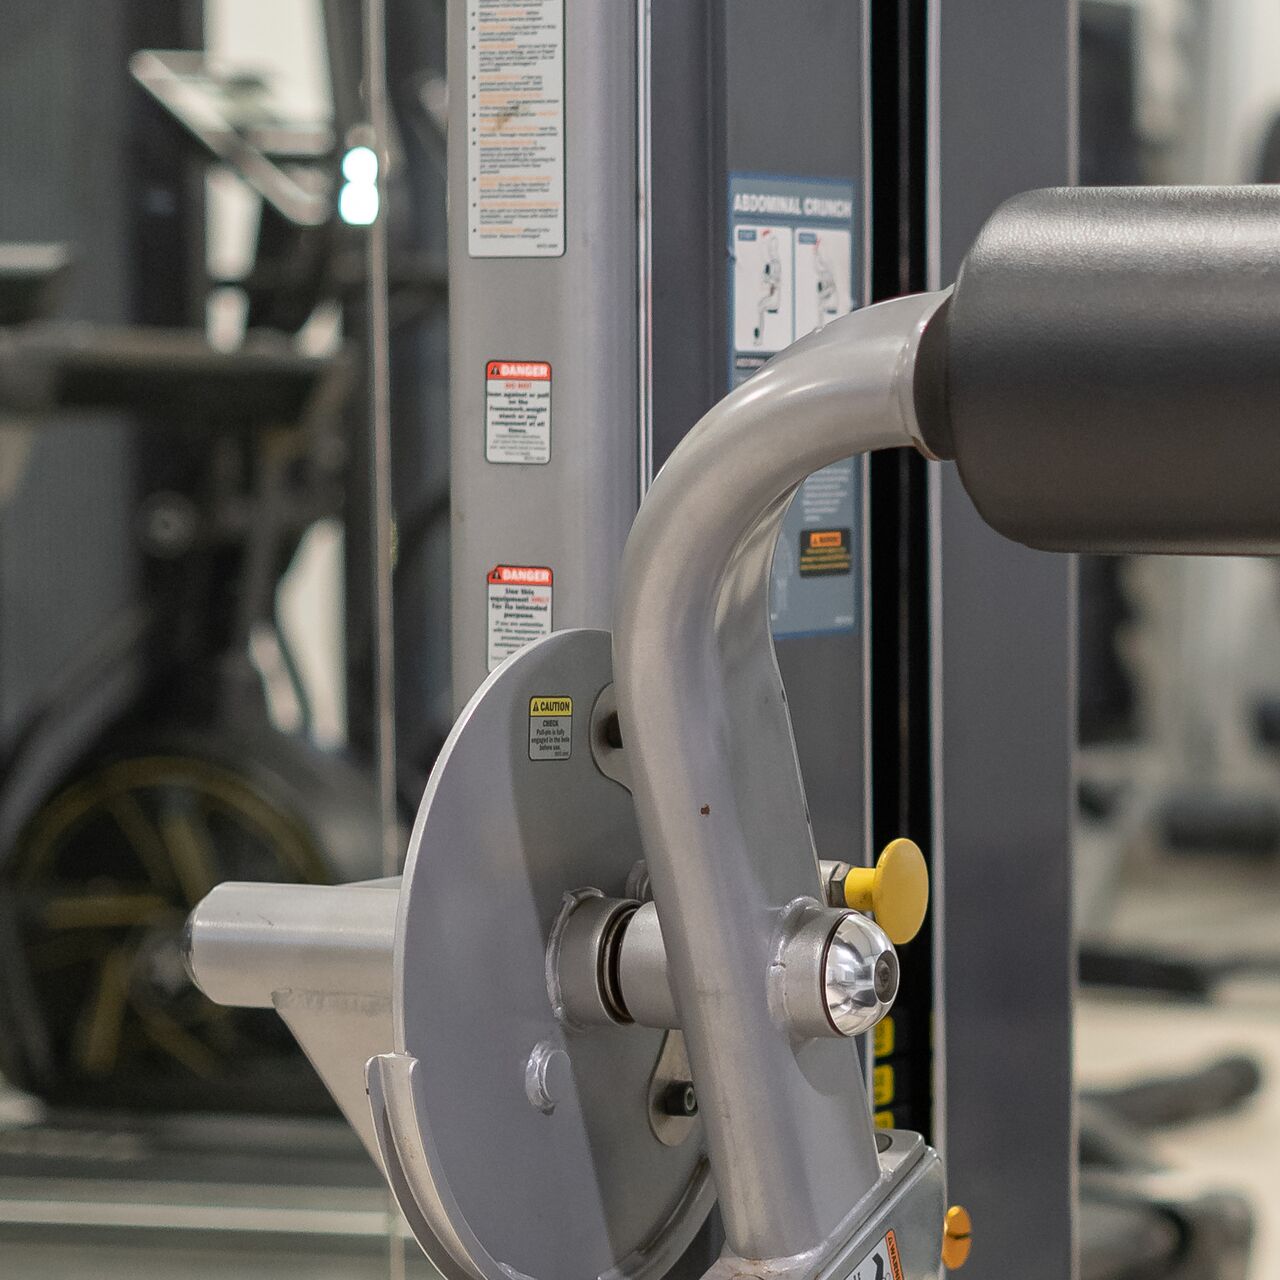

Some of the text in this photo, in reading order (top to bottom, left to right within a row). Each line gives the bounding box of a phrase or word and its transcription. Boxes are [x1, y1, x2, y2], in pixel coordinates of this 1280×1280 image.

[733, 194, 853, 218] ABDOMINAL CRUNCH
[501, 365, 548, 377] DANGER
[501, 567, 550, 582] DANGER
[540, 701, 570, 712] CAUTION
